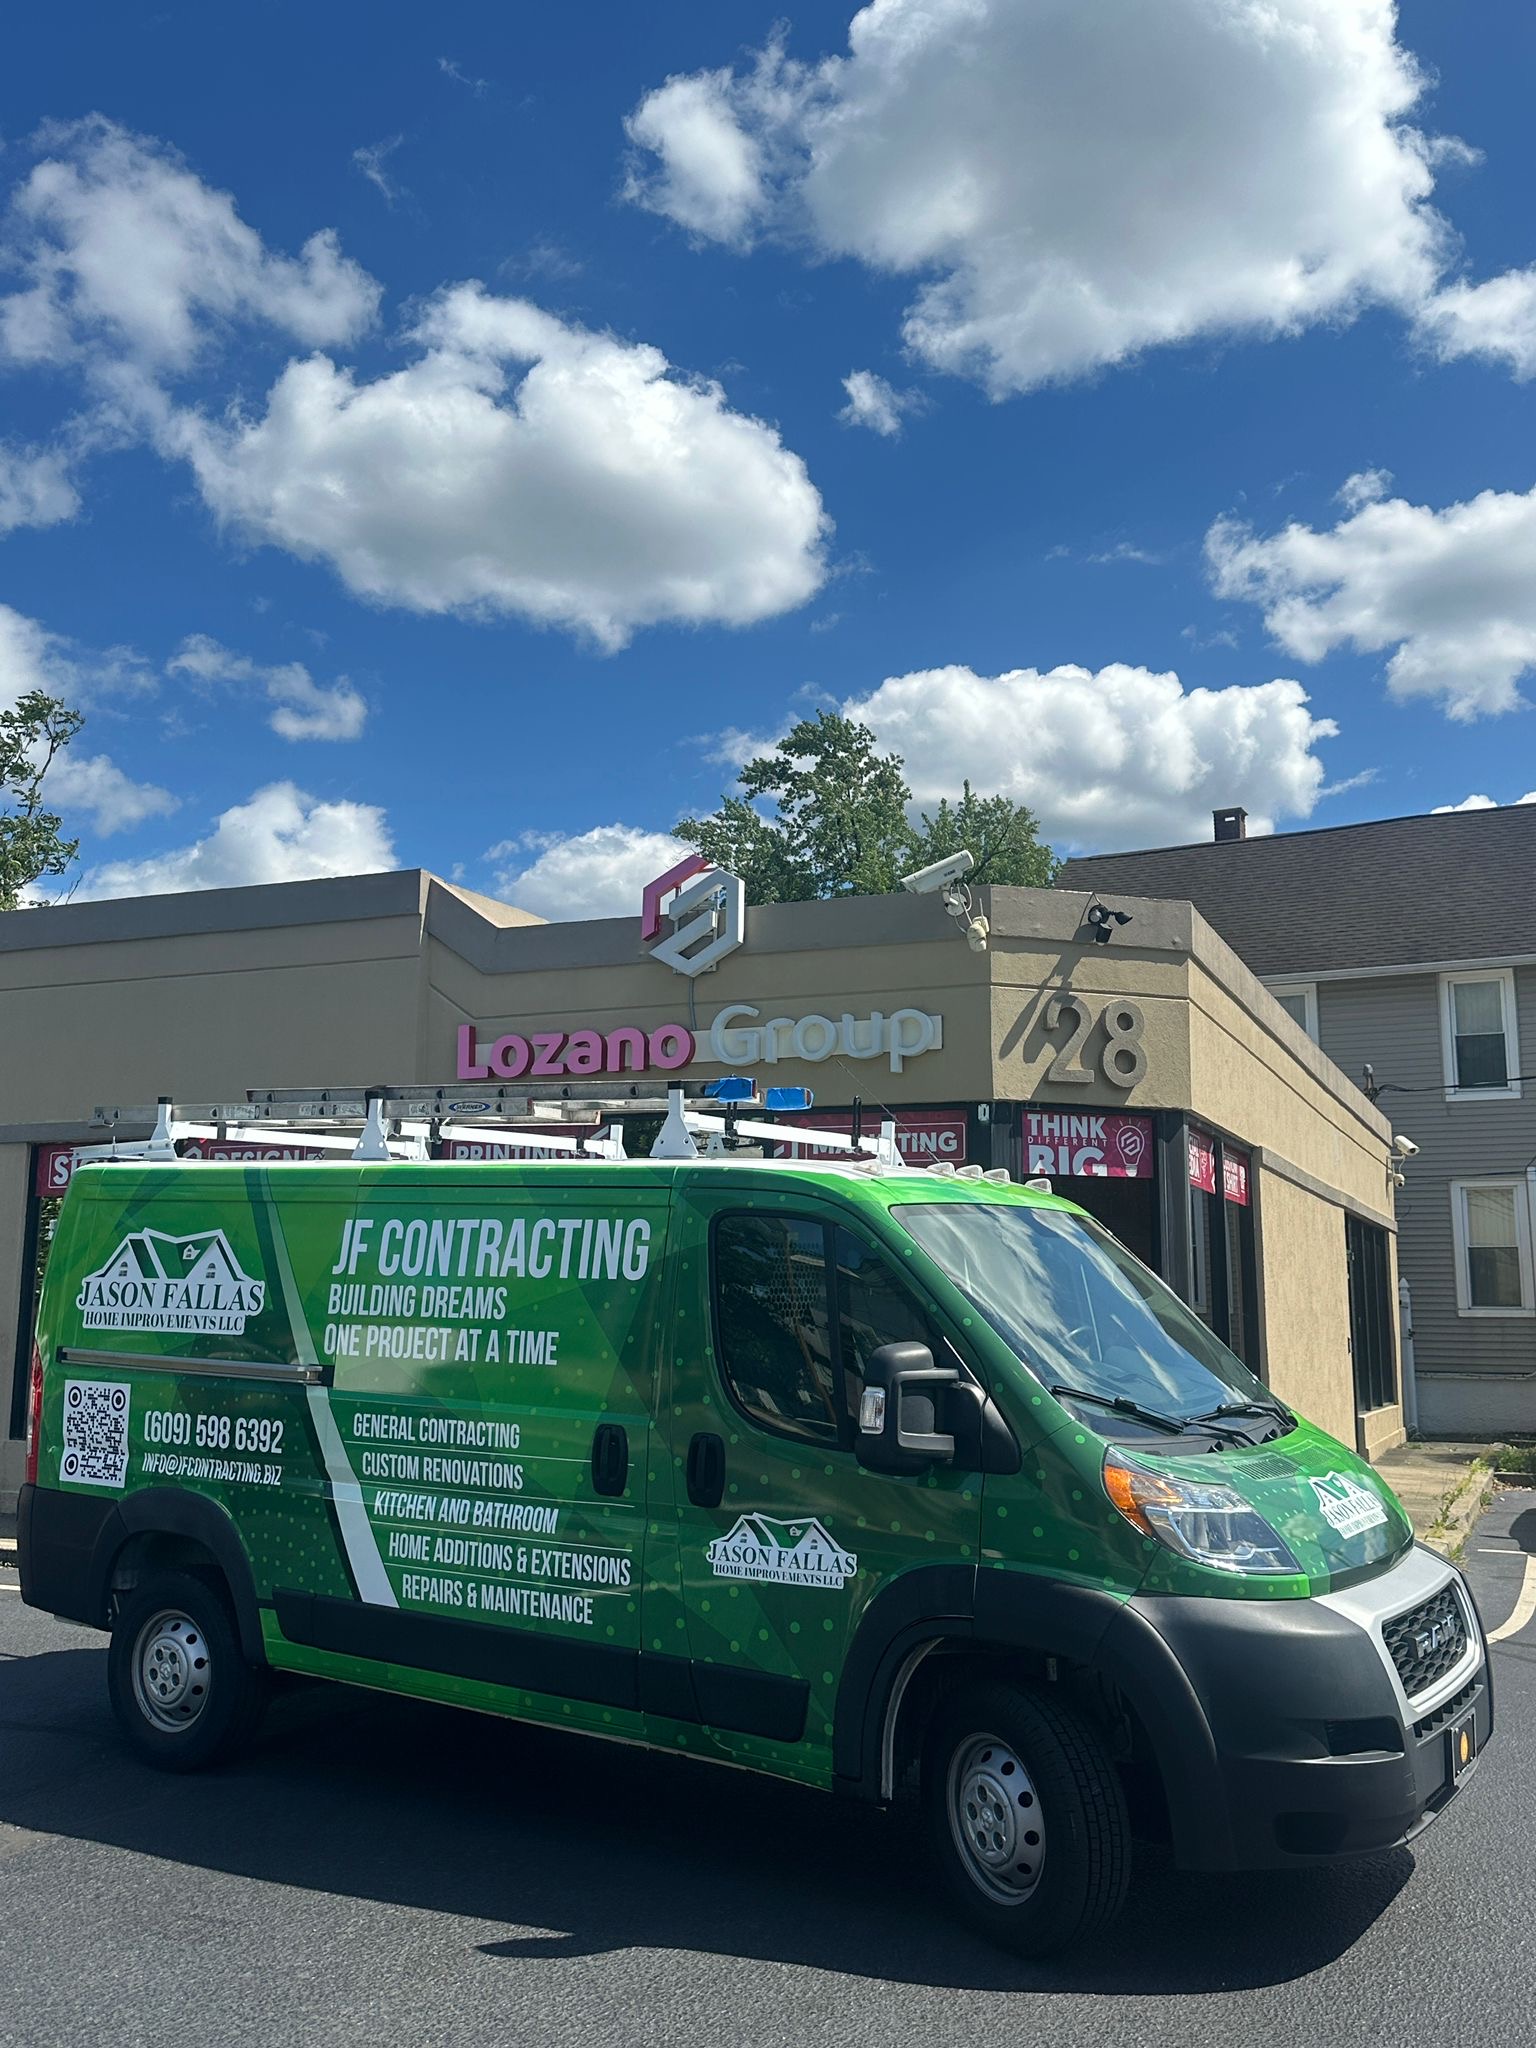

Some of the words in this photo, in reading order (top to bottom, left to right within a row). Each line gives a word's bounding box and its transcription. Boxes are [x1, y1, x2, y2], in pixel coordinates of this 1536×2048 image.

[457, 1024, 695, 1079] Lozano
[711, 1004, 933, 1073] Group
[1046, 993, 1147, 1088] 28
[1027, 1114, 1107, 1138] THINK
[1027, 1136, 1107, 1147] DIFFERENT
[1028, 1144, 1108, 1176] BIG
[332, 1219, 374, 1275] JF
[378, 1218, 650, 1281] CONTRACTING
[79, 1281, 156, 1308] JASON
[161, 1283, 262, 1312] FALLAS
[328, 1284, 415, 1318] BUILDING
[420, 1286, 507, 1320] DREAMS
[85, 1311, 118, 1326] HOME
[121, 1313, 217, 1330] IMPROVEMENTS
[218, 1315, 243, 1331] LLC
[324, 1324, 361, 1356] ONE
[365, 1326, 451, 1361] PROJECT
[455, 1328, 482, 1362] AT
[485, 1330, 499, 1363] A
[507, 1329, 559, 1365] TIME
[144, 1411, 191, 1445] (609)
[196, 1414, 231, 1449] 598
[235, 1417, 284, 1453] 6392
[353, 1413, 415, 1441] GENERAL
[419, 1417, 520, 1449] CONTRACTING
[142, 1452, 283, 1486] INFO@JFCONTRACTING.BIZ
[362, 1452, 419, 1480] CUSTOM
[423, 1456, 523, 1490] RENOVATIONS
[374, 1490, 435, 1520] KITCHEN
[438, 1498, 471, 1525] AND
[472, 1501, 559, 1534] BATHROOM
[388, 1532, 431, 1561] HOME
[433, 1537, 513, 1572] ADDITIONS
[516, 1547, 527, 1573] &
[531, 1548, 632, 1586] EXTENSIONS
[708, 1543, 771, 1566] JASON
[777, 1551, 856, 1575] FALLAS
[715, 1563, 743, 1576] HOME
[744, 1567, 822, 1584] IMPROVEMENTS
[823, 1575, 844, 1587] LLC
[402, 1574, 463, 1606] REPAIRS
[467, 1582, 477, 1608] &
[481, 1584, 594, 1625] MAINTENANCE
